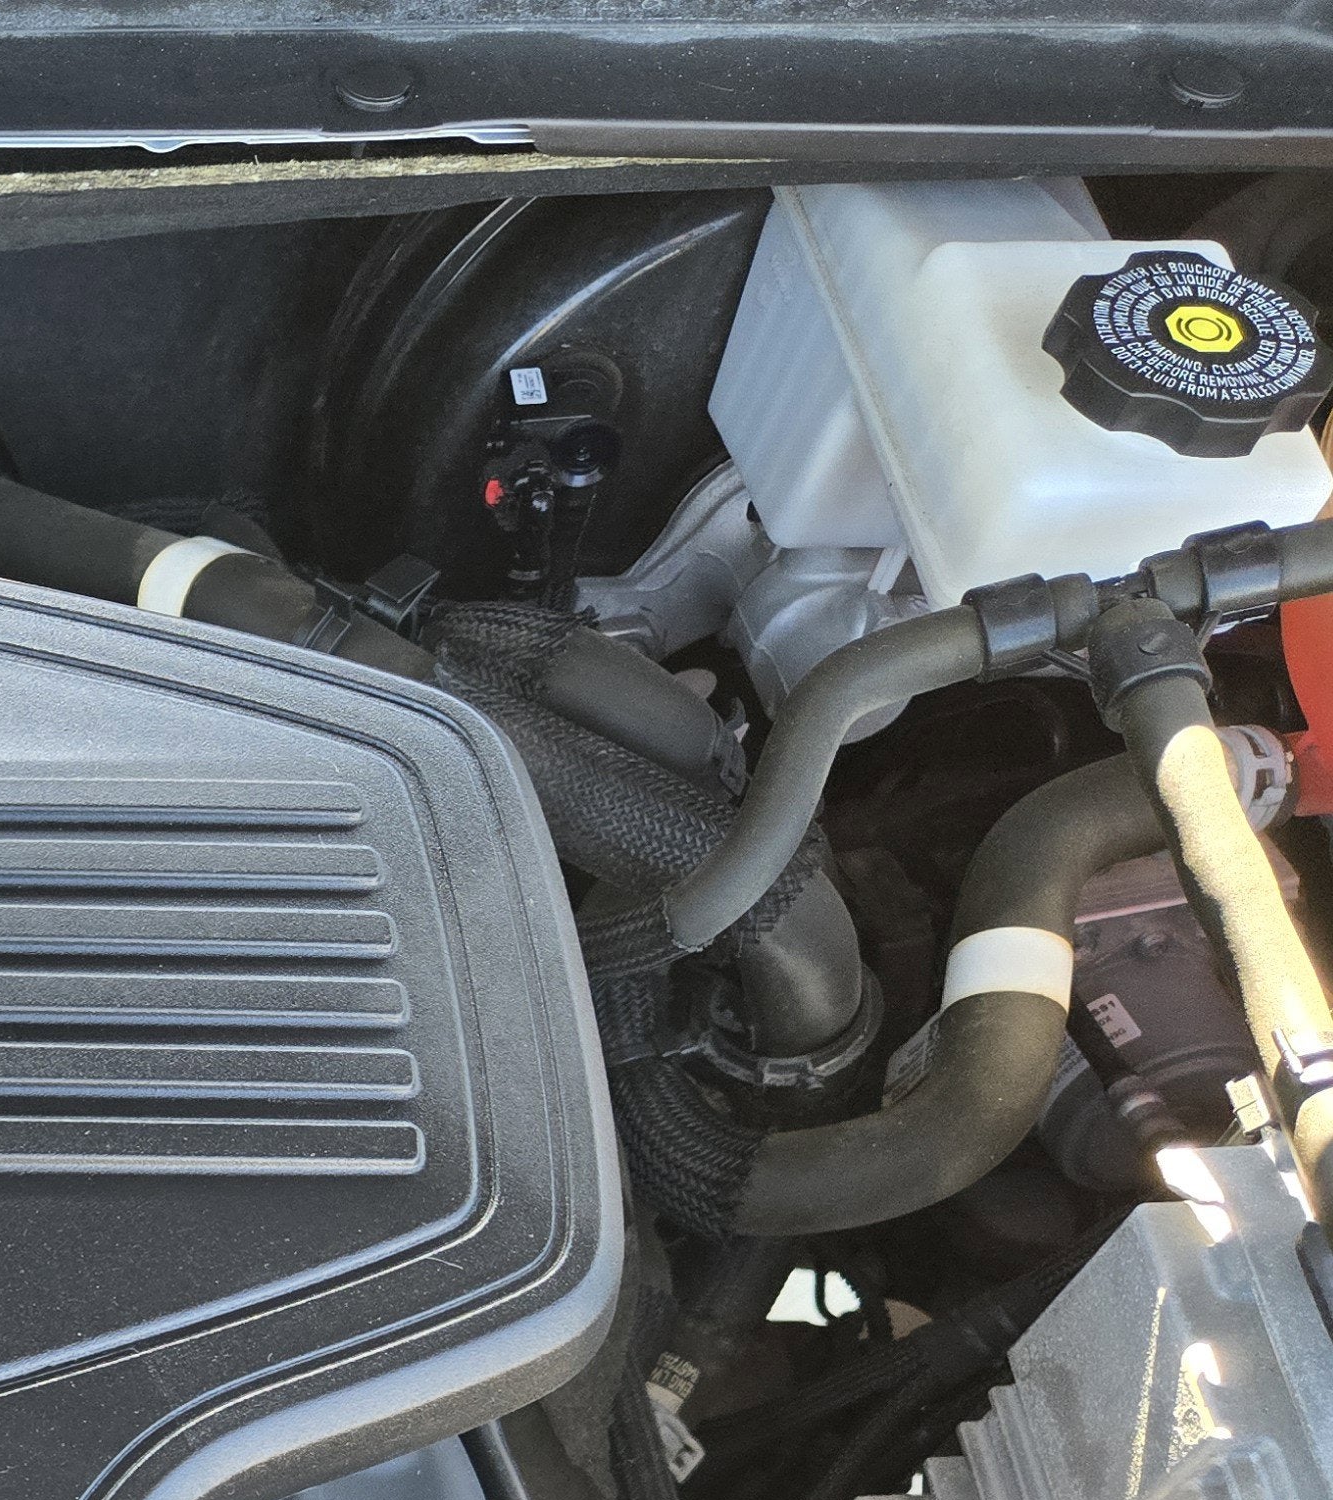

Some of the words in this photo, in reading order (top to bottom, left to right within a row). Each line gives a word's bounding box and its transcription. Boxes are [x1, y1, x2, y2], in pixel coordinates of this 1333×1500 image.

[1100, 266, 1150, 297] NETTOYER
[1148, 263, 1166, 275] LE
[1168, 261, 1230, 280] BOUCHON
[1232, 274, 1275, 297] AVANT
[1270, 296, 1290, 310] LA
[1283, 309, 1315, 344] DEPOSE
[1130, 279, 1155, 294] QUE
[1153, 274, 1172, 287] DU
[1174, 274, 1225, 290] LIQUIDE
[1227, 284, 1246, 297] DE
[1244, 293, 1280, 318] FREIN
[1272, 318, 1295, 340] DOT3
[1132, 291, 1163, 336] PROVENANT
[1160, 285, 1193, 299] D'UN
[1197, 286, 1239, 307] BIDON
[1111, 346, 1142, 369] DOT3
[1137, 365, 1177, 388] FLUID
[1178, 381, 1217, 399] FROM
[1221, 388, 1230, 400] A
[1230, 382, 1279, 401] SEALED
[1126, 341, 1151, 358] CAP
[1146, 356, 1197, 383] BEFORE
[1262, 361, 1288, 377] USE
[1275, 341, 1296, 364] ONLY
[1211, 360, 1254, 375] CLEAN
[1247, 339, 1276, 367] FILLER
